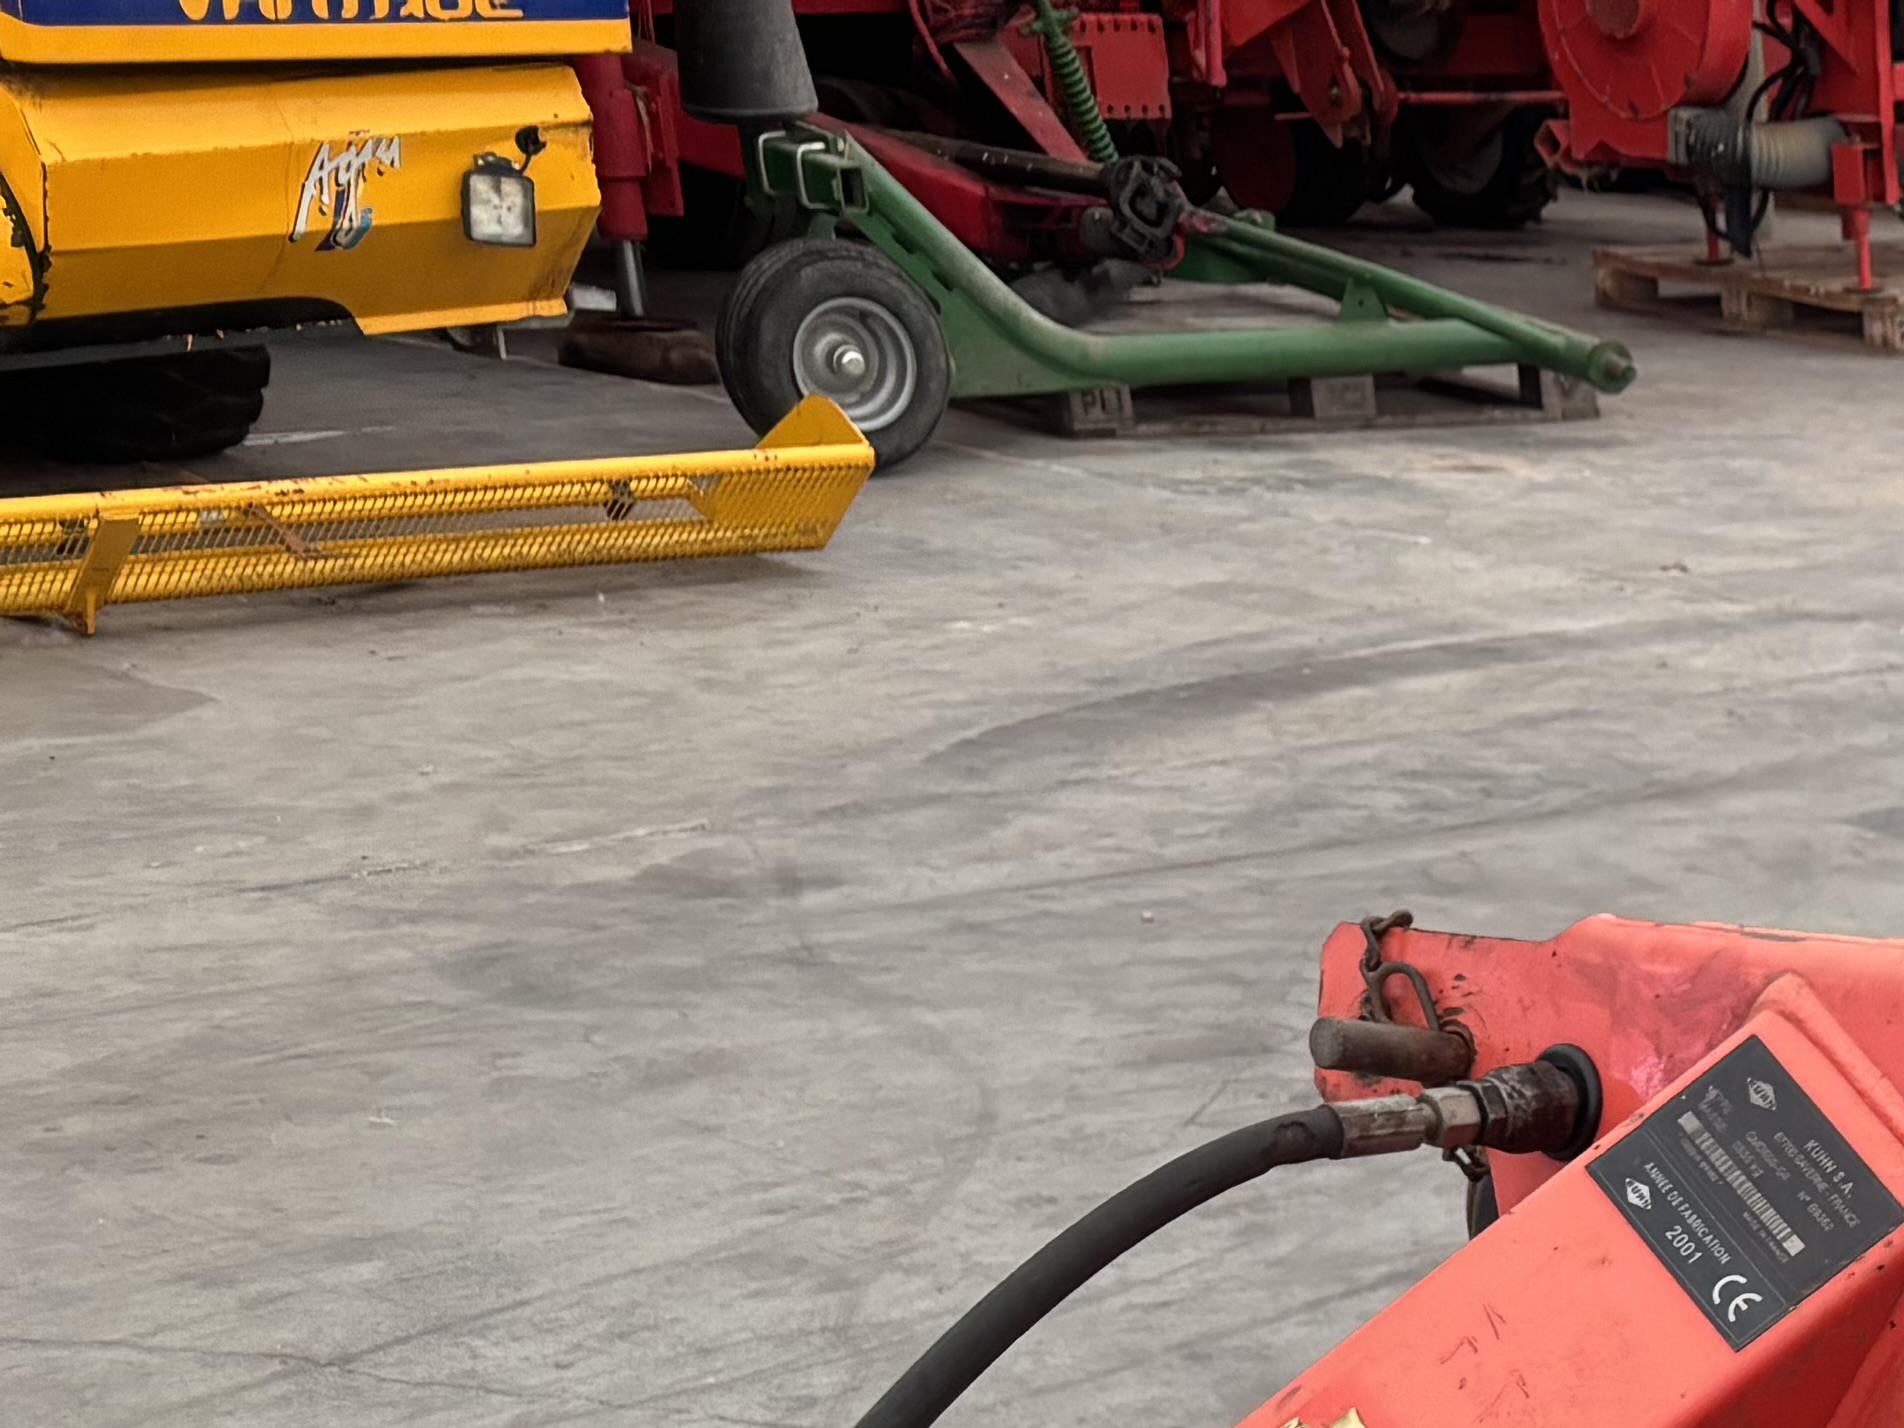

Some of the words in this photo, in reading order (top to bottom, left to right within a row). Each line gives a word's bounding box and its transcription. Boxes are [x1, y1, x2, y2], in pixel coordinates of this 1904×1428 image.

[1803, 1139, 1837, 1173] KUHN
[1664, 1225, 1702, 1263] 2001
[1666, 1190, 1683, 1206] DE
[1677, 1203, 1731, 1264] FABRICATION
